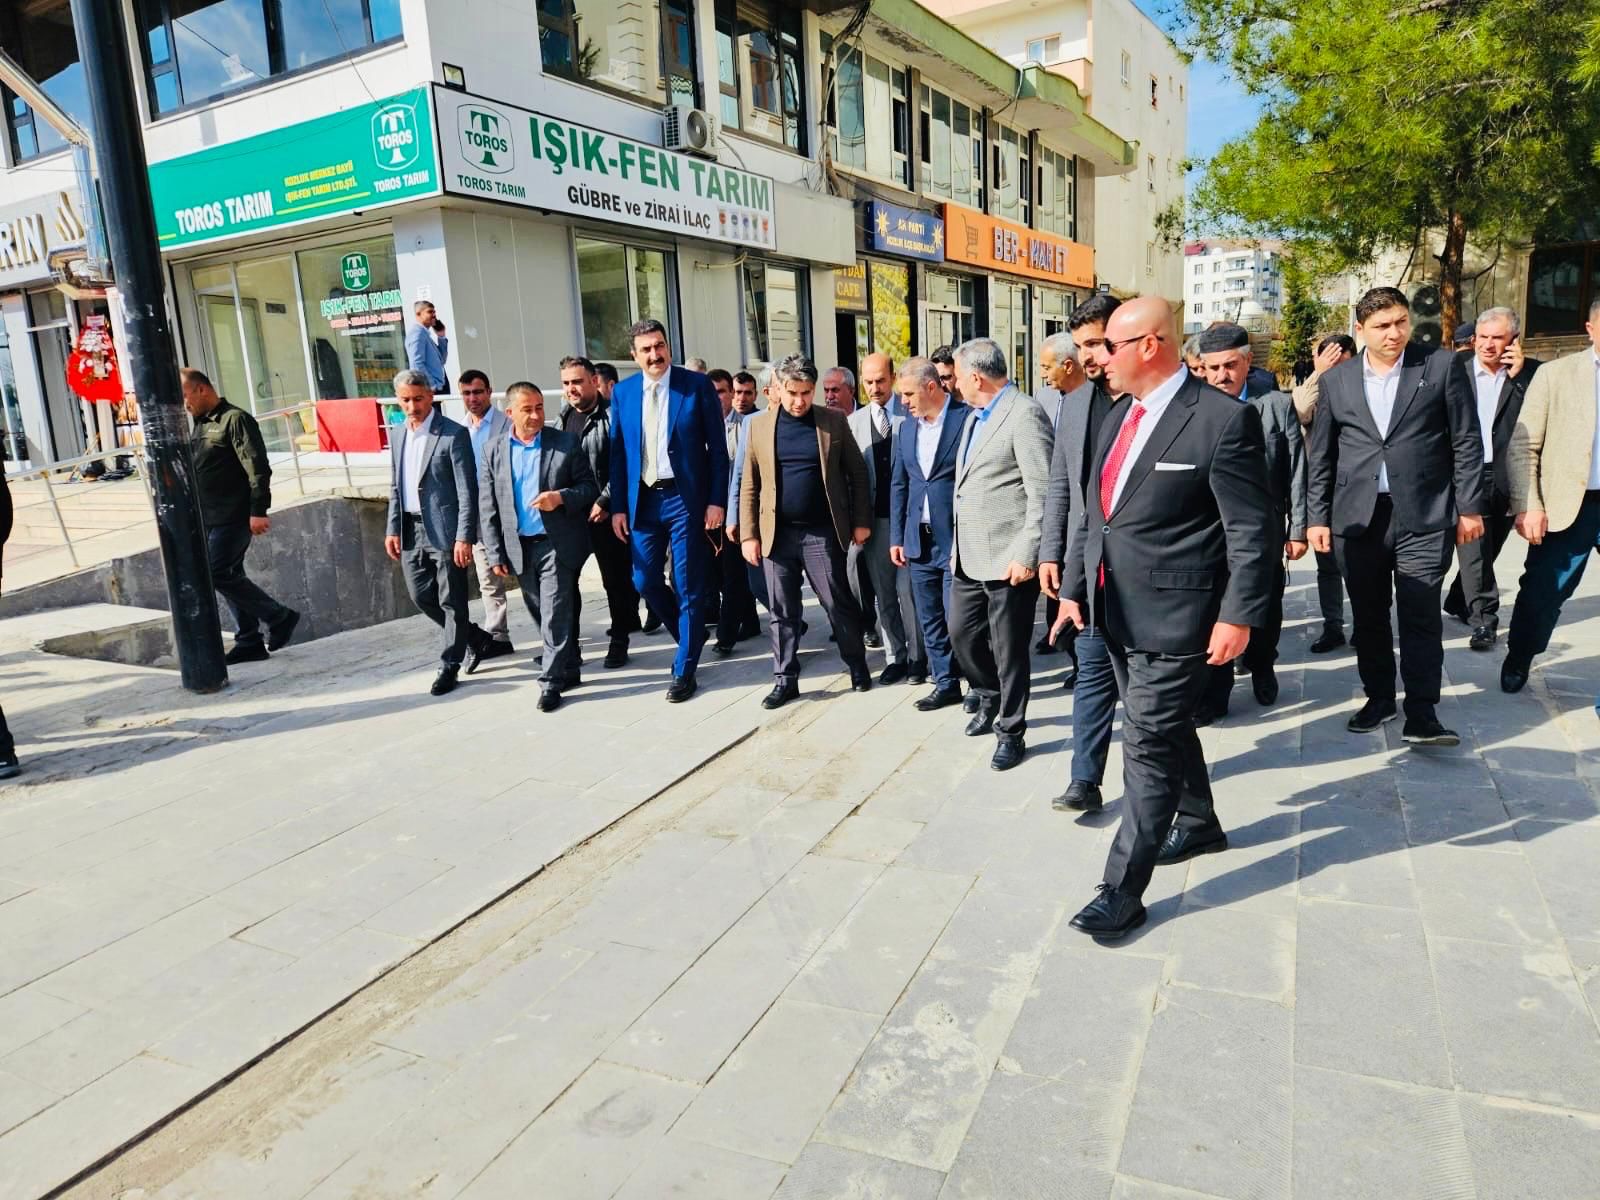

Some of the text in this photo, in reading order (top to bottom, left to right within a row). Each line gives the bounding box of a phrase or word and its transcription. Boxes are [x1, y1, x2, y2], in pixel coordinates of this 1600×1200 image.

[377, 129, 413, 151] TOROS
[465, 130, 508, 153] TOROS
[529, 116, 770, 212] IŞIK-FEN TARIM
[374, 169, 430, 193] TOROS TARIM
[457, 174, 526, 199] TOROS TARIM
[175, 189, 274, 235] TOROS TARIM
[568, 182, 712, 235] GÜBRE ve ZİRAİ İLAÇ
[992, 225, 1019, 264] BER
[345, 267, 367, 279] TOROS
[836, 282, 861, 298] CAFE
